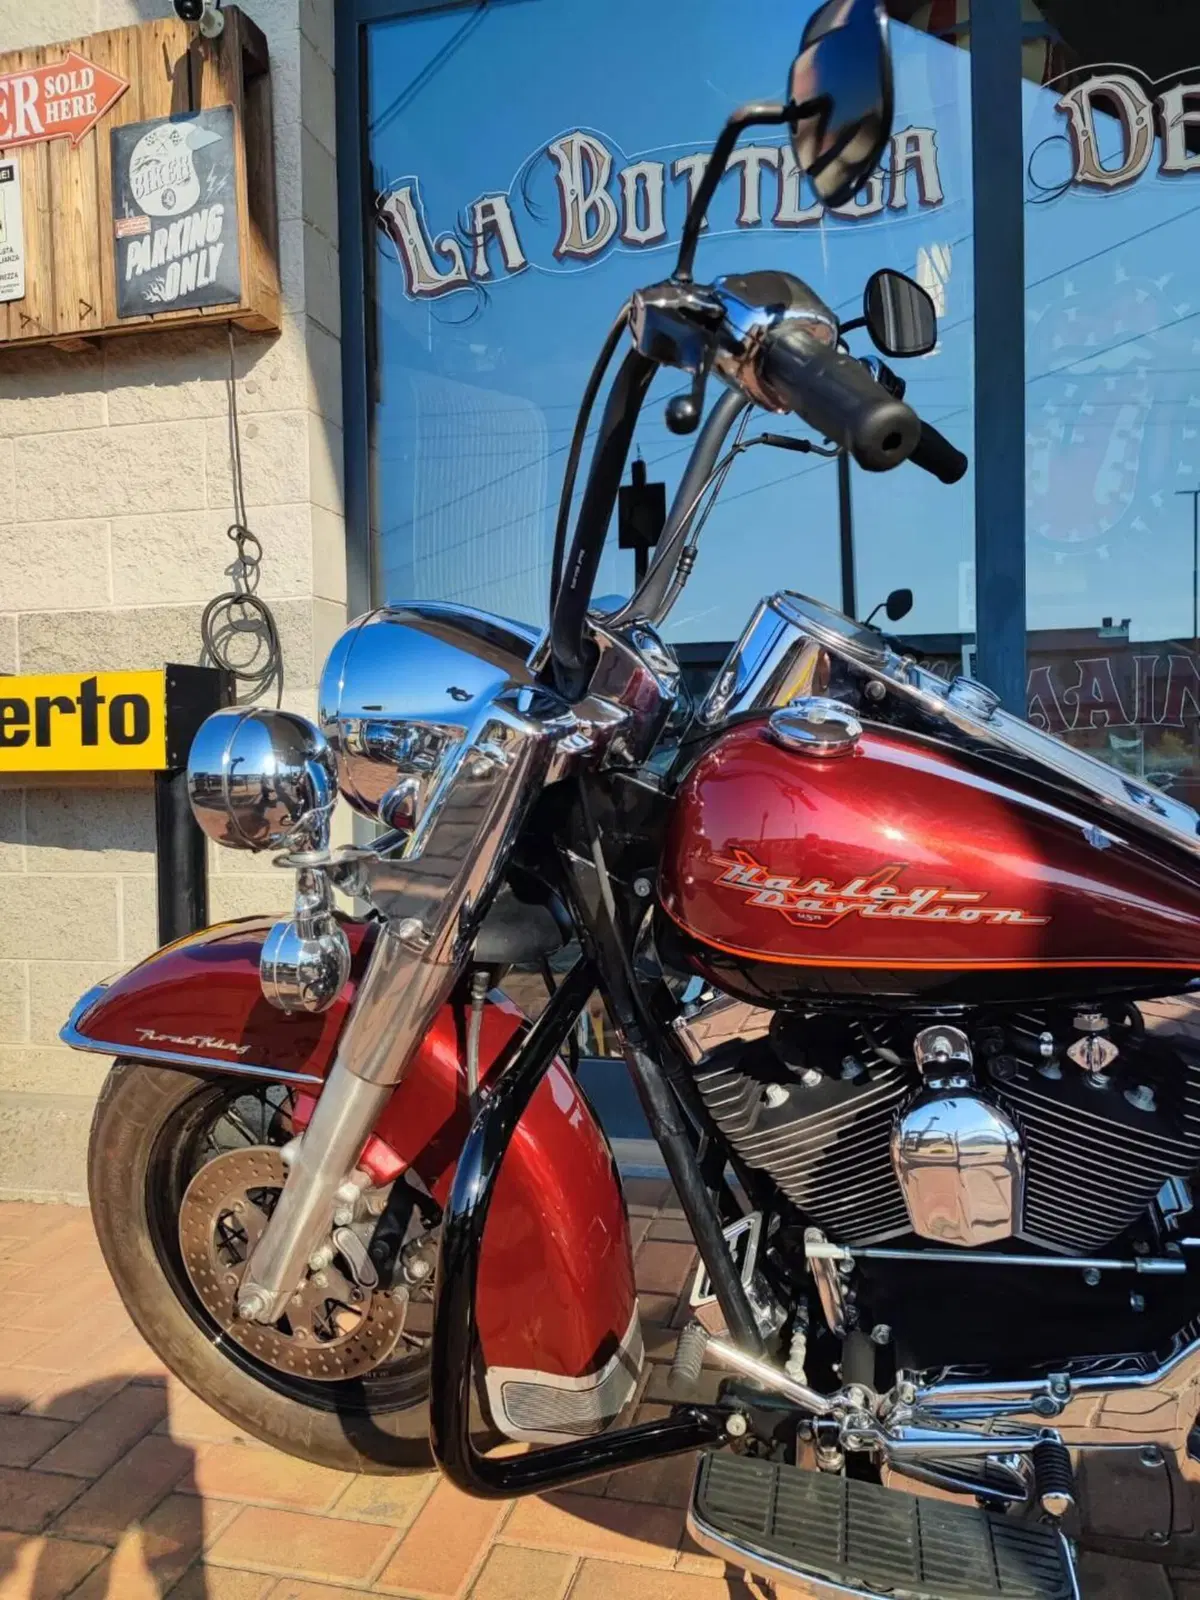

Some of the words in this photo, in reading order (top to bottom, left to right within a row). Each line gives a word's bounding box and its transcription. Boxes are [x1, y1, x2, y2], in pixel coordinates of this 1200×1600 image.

[44, 67, 94, 99] SOLD
[45, 92, 97, 124] HERE
[125, 203, 225, 282] PARKING
[164, 242, 225, 302] ONLY
[376, 186, 528, 298] LA
[0, 676, 150, 747] erto
[748, 888, 1049, 925] Davidson
